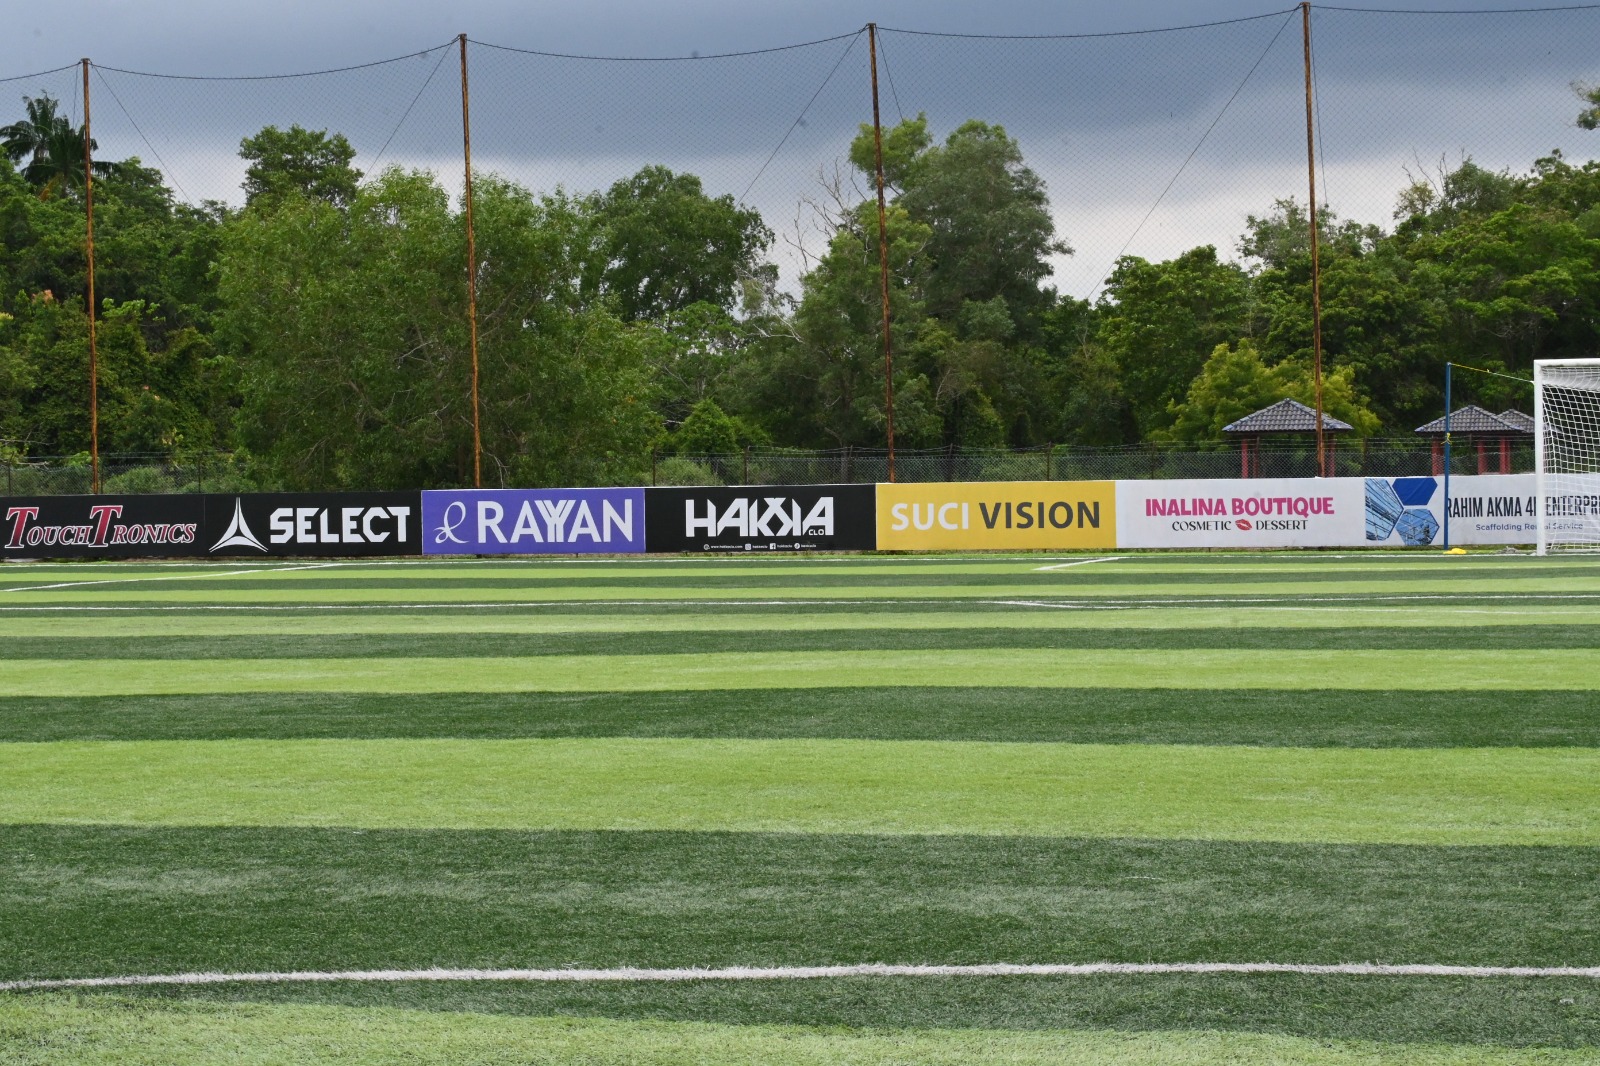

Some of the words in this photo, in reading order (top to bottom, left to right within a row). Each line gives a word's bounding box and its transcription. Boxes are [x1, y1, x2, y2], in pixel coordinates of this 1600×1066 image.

[685, 497, 834, 537] HAKKA
[891, 503, 969, 531] SUCI
[979, 501, 1100, 529] VISION
[1145, 498, 1227, 517] INALINA
[1231, 497, 1335, 518] BOUTIQUE
[1487, 497, 1523, 517] AKMA
[270, 507, 411, 544] SELECT
[477, 499, 633, 543] RAYYAN
[1172, 520, 1232, 532] COSMETIC
[1256, 519, 1309, 531] DESSERT
[1475, 523, 1522, 532] Scaffolding
[1552, 522, 1584, 531] Service
[808, 528, 825, 536] CLO
